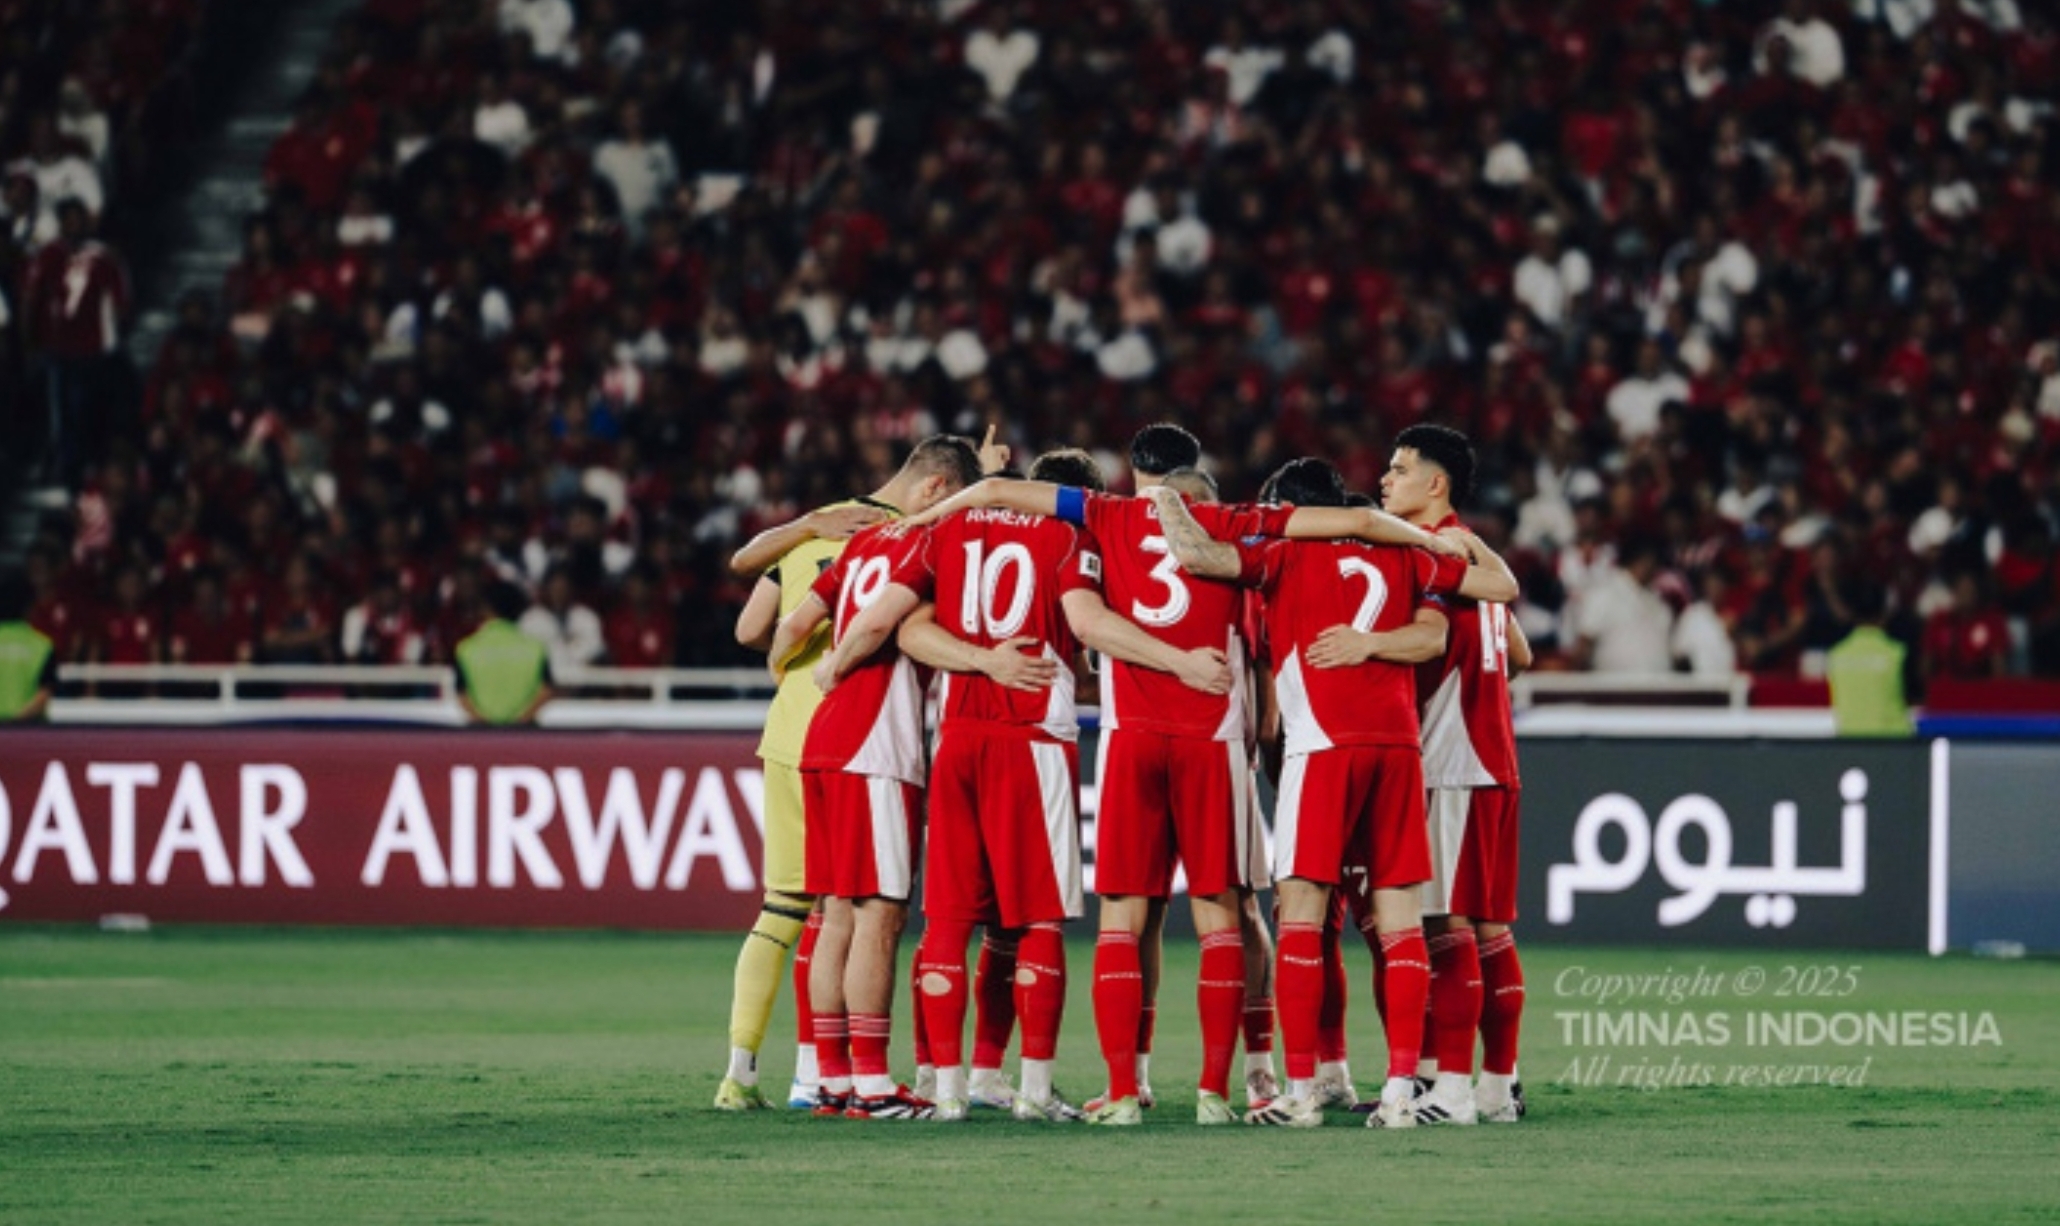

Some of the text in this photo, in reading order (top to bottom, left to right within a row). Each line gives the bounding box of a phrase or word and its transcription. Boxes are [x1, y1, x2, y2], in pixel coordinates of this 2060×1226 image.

[963, 539, 1036, 638] 10
[1132, 534, 1191, 627] 3
[1337, 555, 1388, 633] 2
[0, 760, 314, 910] ATAR
[1343, 866, 1368, 897] 7
[1547, 768, 1868, 927] نيوم
